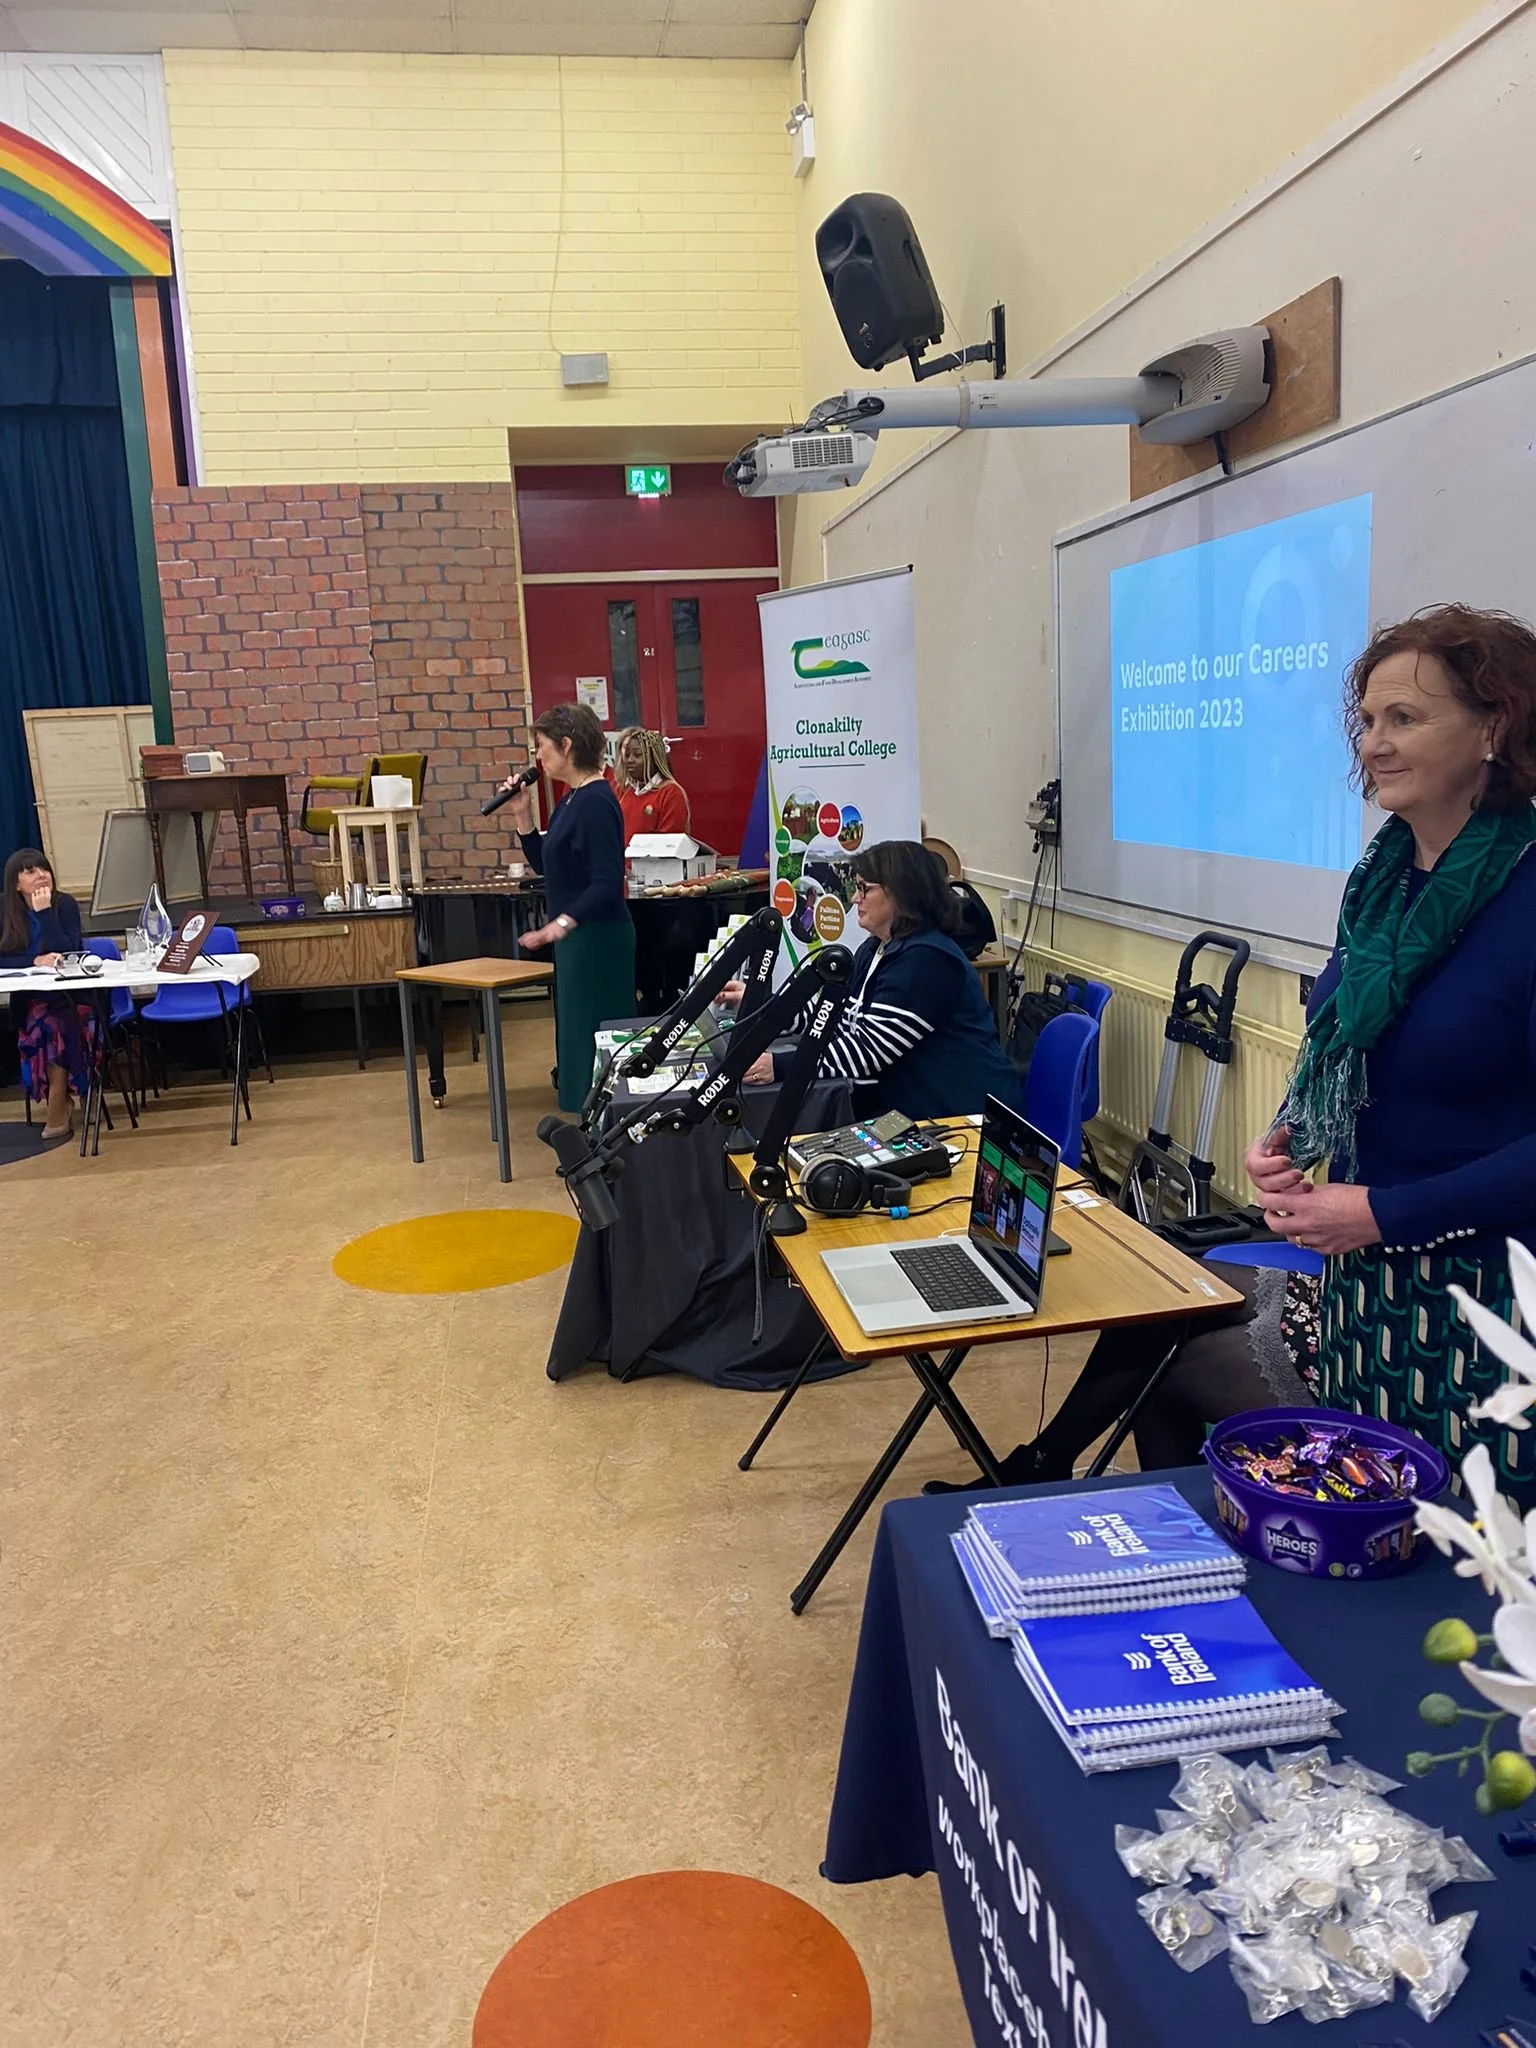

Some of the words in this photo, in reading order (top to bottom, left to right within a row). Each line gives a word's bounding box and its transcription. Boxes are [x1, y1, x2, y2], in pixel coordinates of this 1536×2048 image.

[1120, 659, 1186, 689] Welcome
[1191, 653, 1208, 682] to
[1213, 652, 1244, 679] our
[1249, 640, 1329, 675] Careers
[795, 716, 863, 736] Clonakilty
[1121, 701, 1195, 733] Exhibition
[1199, 696, 1244, 729] 2023
[770, 741, 845, 763] Agricultural
[848, 739, 897, 760] College
[662, 1018, 689, 1049] RØDE
[809, 999, 835, 1039] RØDE
[697, 1072, 730, 1107] RØDE
[1081, 1515, 1106, 1528] of
[1101, 1513, 1150, 1554] Ireland
[1095, 1527, 1131, 1557] Bank
[1266, 1529, 1318, 1556] HEROES
[1140, 1633, 1169, 1648] of
[1163, 1632, 1217, 1683] Ireland
[1155, 1649, 1195, 1686] Bank
[935, 1665, 1004, 1872] Bank
[1007, 1838, 1042, 1944] of
